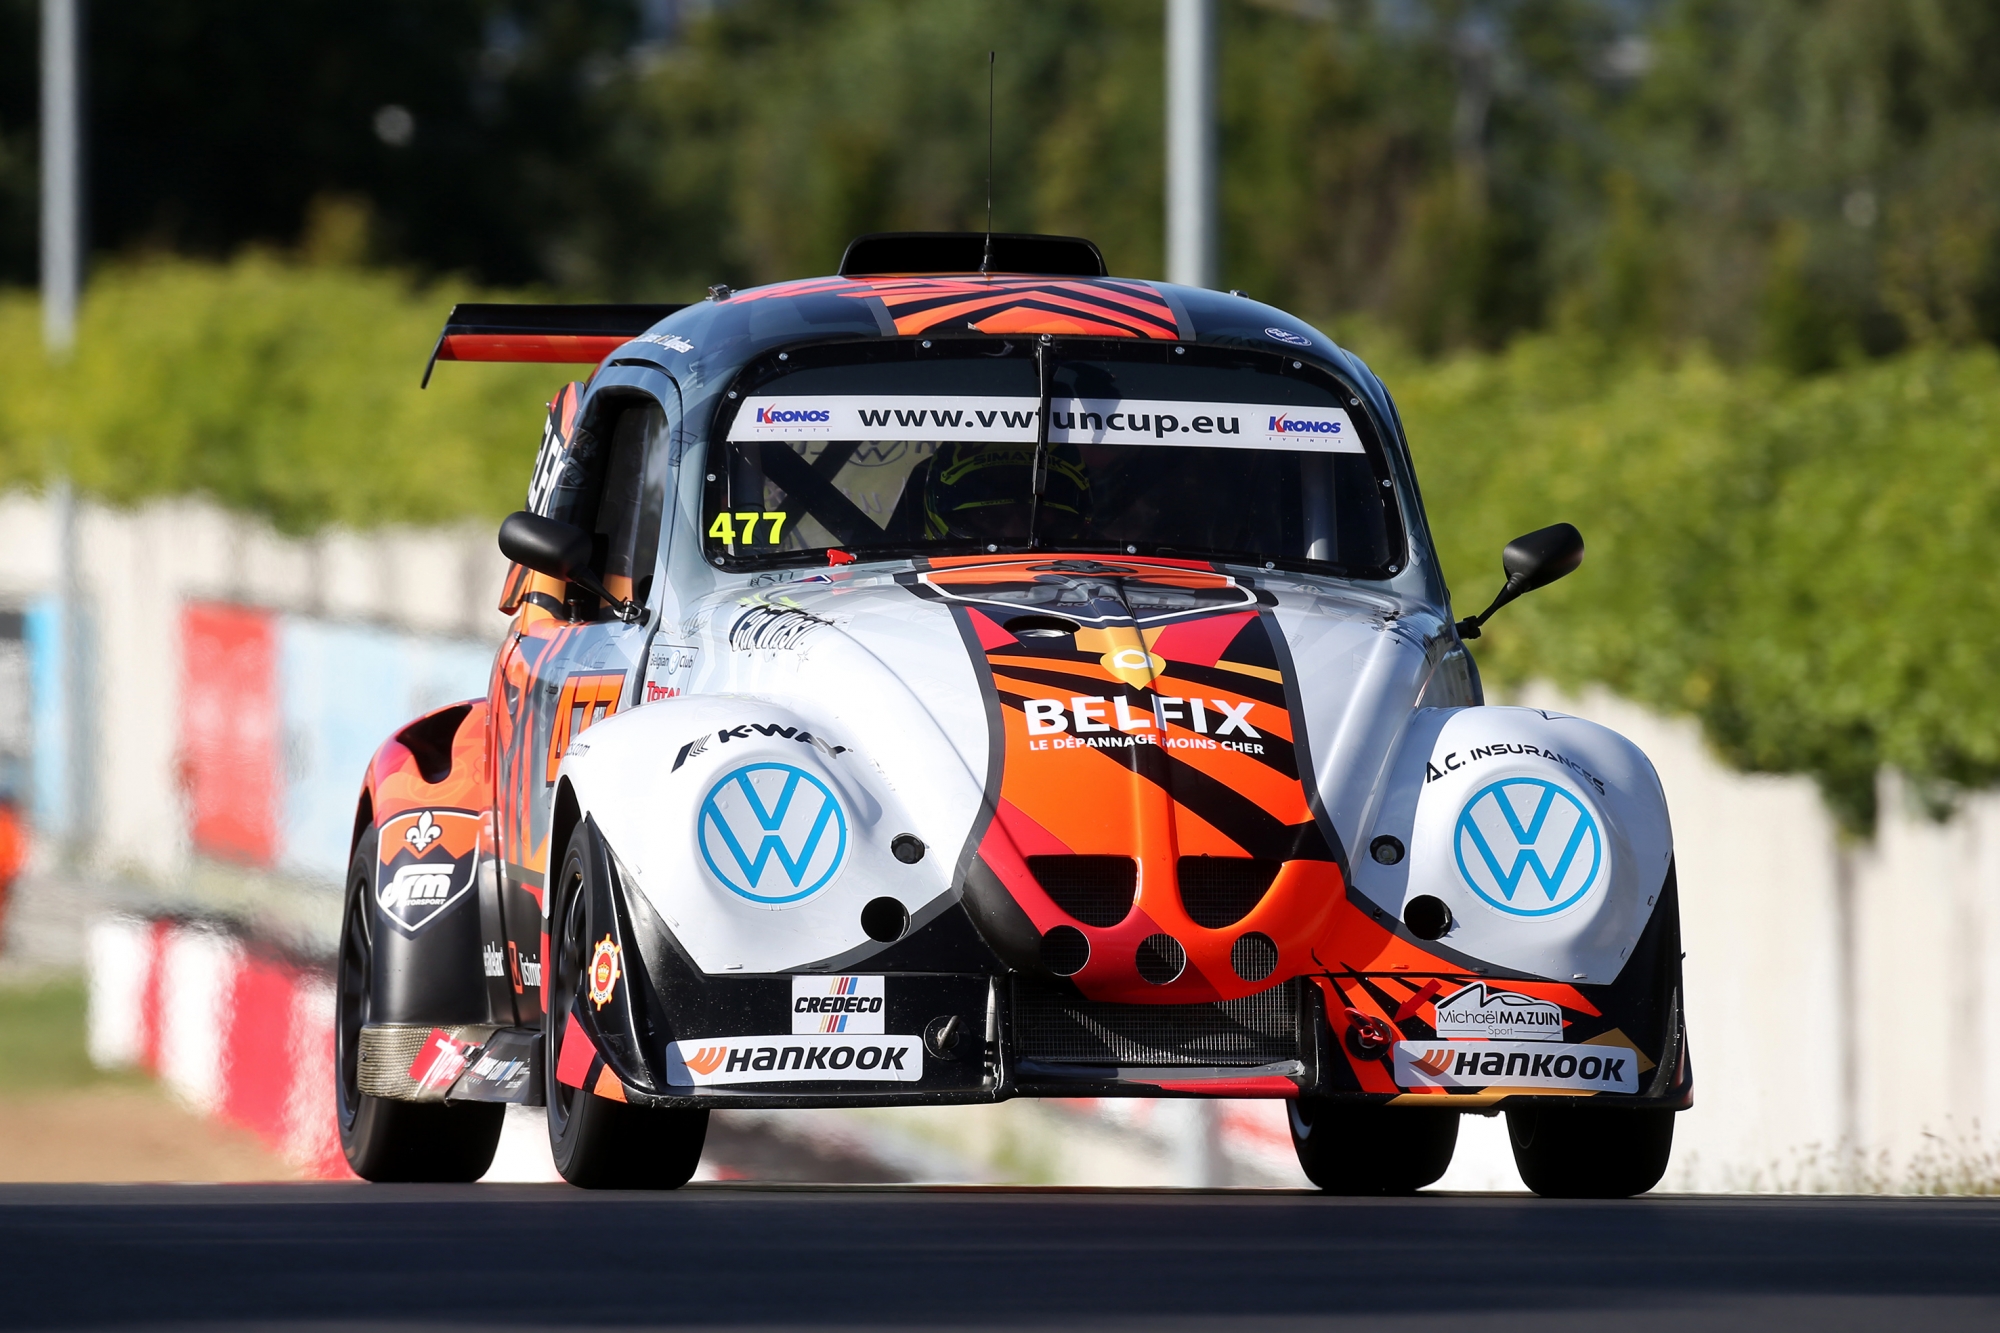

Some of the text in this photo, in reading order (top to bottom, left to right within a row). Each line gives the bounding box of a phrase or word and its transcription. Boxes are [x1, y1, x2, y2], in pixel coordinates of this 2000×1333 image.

[756, 403, 830, 424] KRONOS
[858, 407, 1240, 438] www.vwuncup.eu
[1269, 412, 1341, 434] KRONOS
[708, 511, 787, 545] 477
[1023, 694, 1262, 738] BELFIX
[1029, 734, 1265, 755] LE DÉPANNAGE MOINS CHER
[1426, 744, 1605, 796] A.C. INSURANCES
[794, 997, 883, 1013] CREDECO
[1487, 1025, 1513, 1037] Sport
